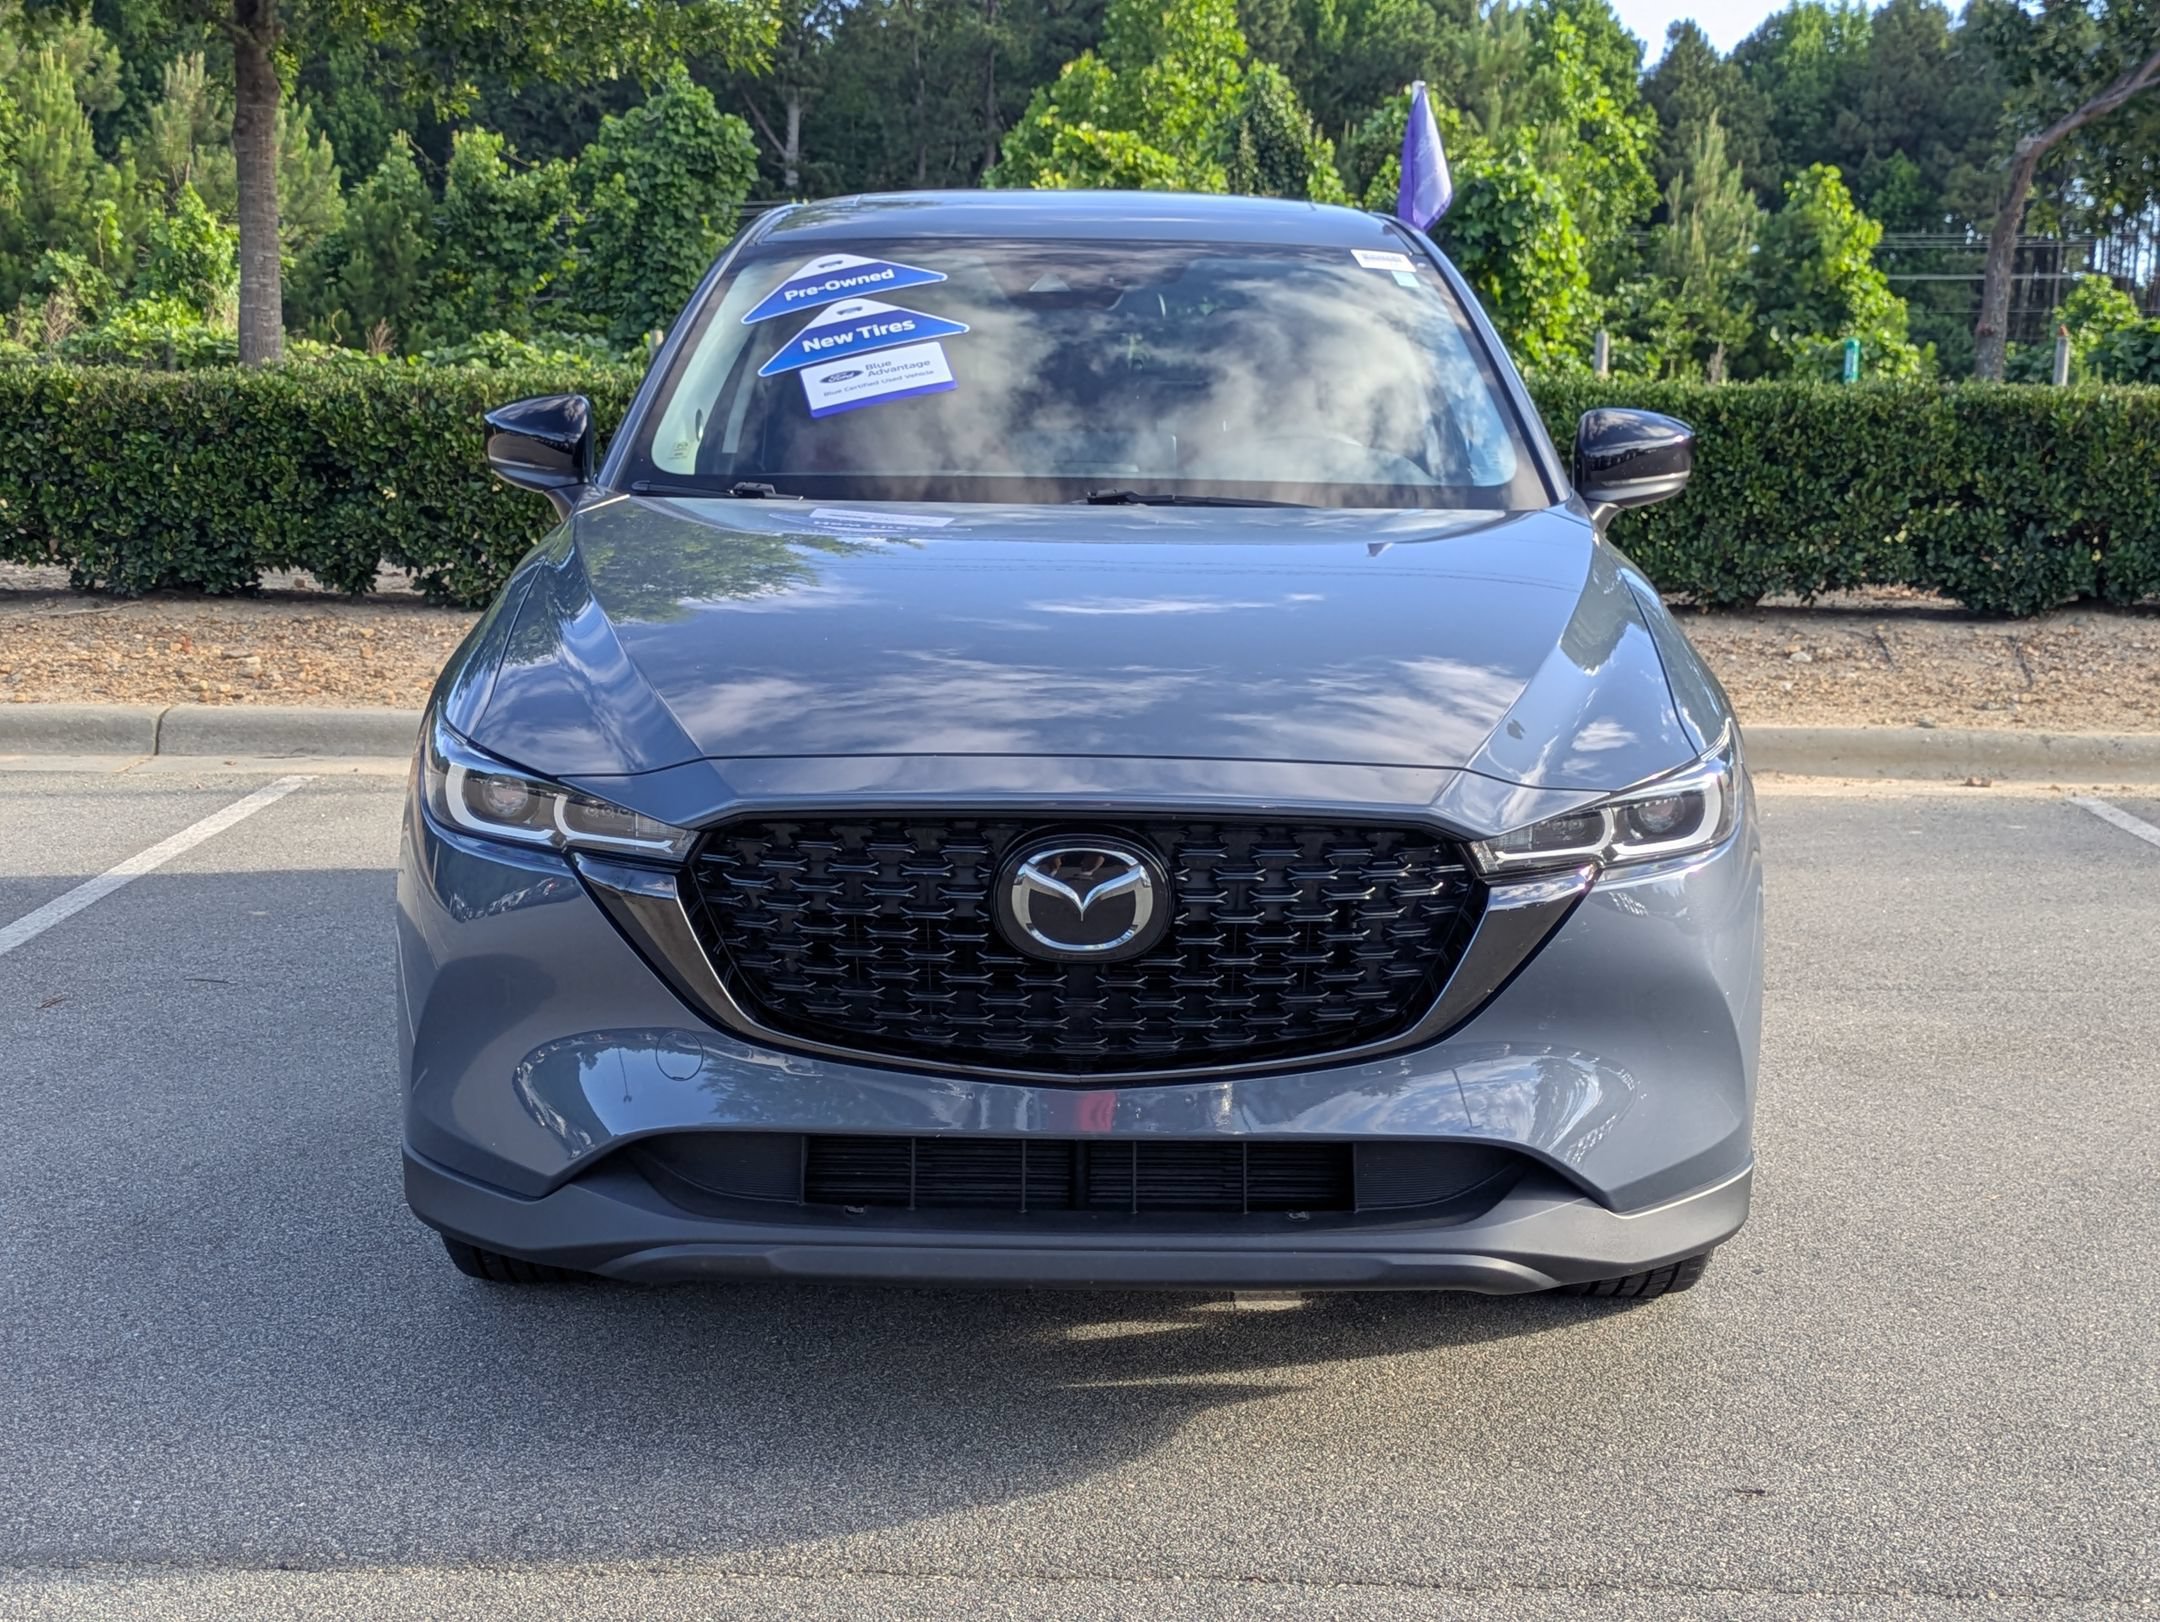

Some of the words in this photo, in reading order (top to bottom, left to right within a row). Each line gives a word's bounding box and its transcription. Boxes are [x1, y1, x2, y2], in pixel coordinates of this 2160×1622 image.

[784, 268, 895, 301] Pre-Owned
[802, 331, 854, 353] New
[856, 319, 916, 339] Tires
[865, 360, 892, 370] Blue
[867, 360, 931, 377] Advantage
[844, 380, 880, 392] Certified
[881, 375, 903, 384] Used
[904, 370, 935, 379] Vehicle
